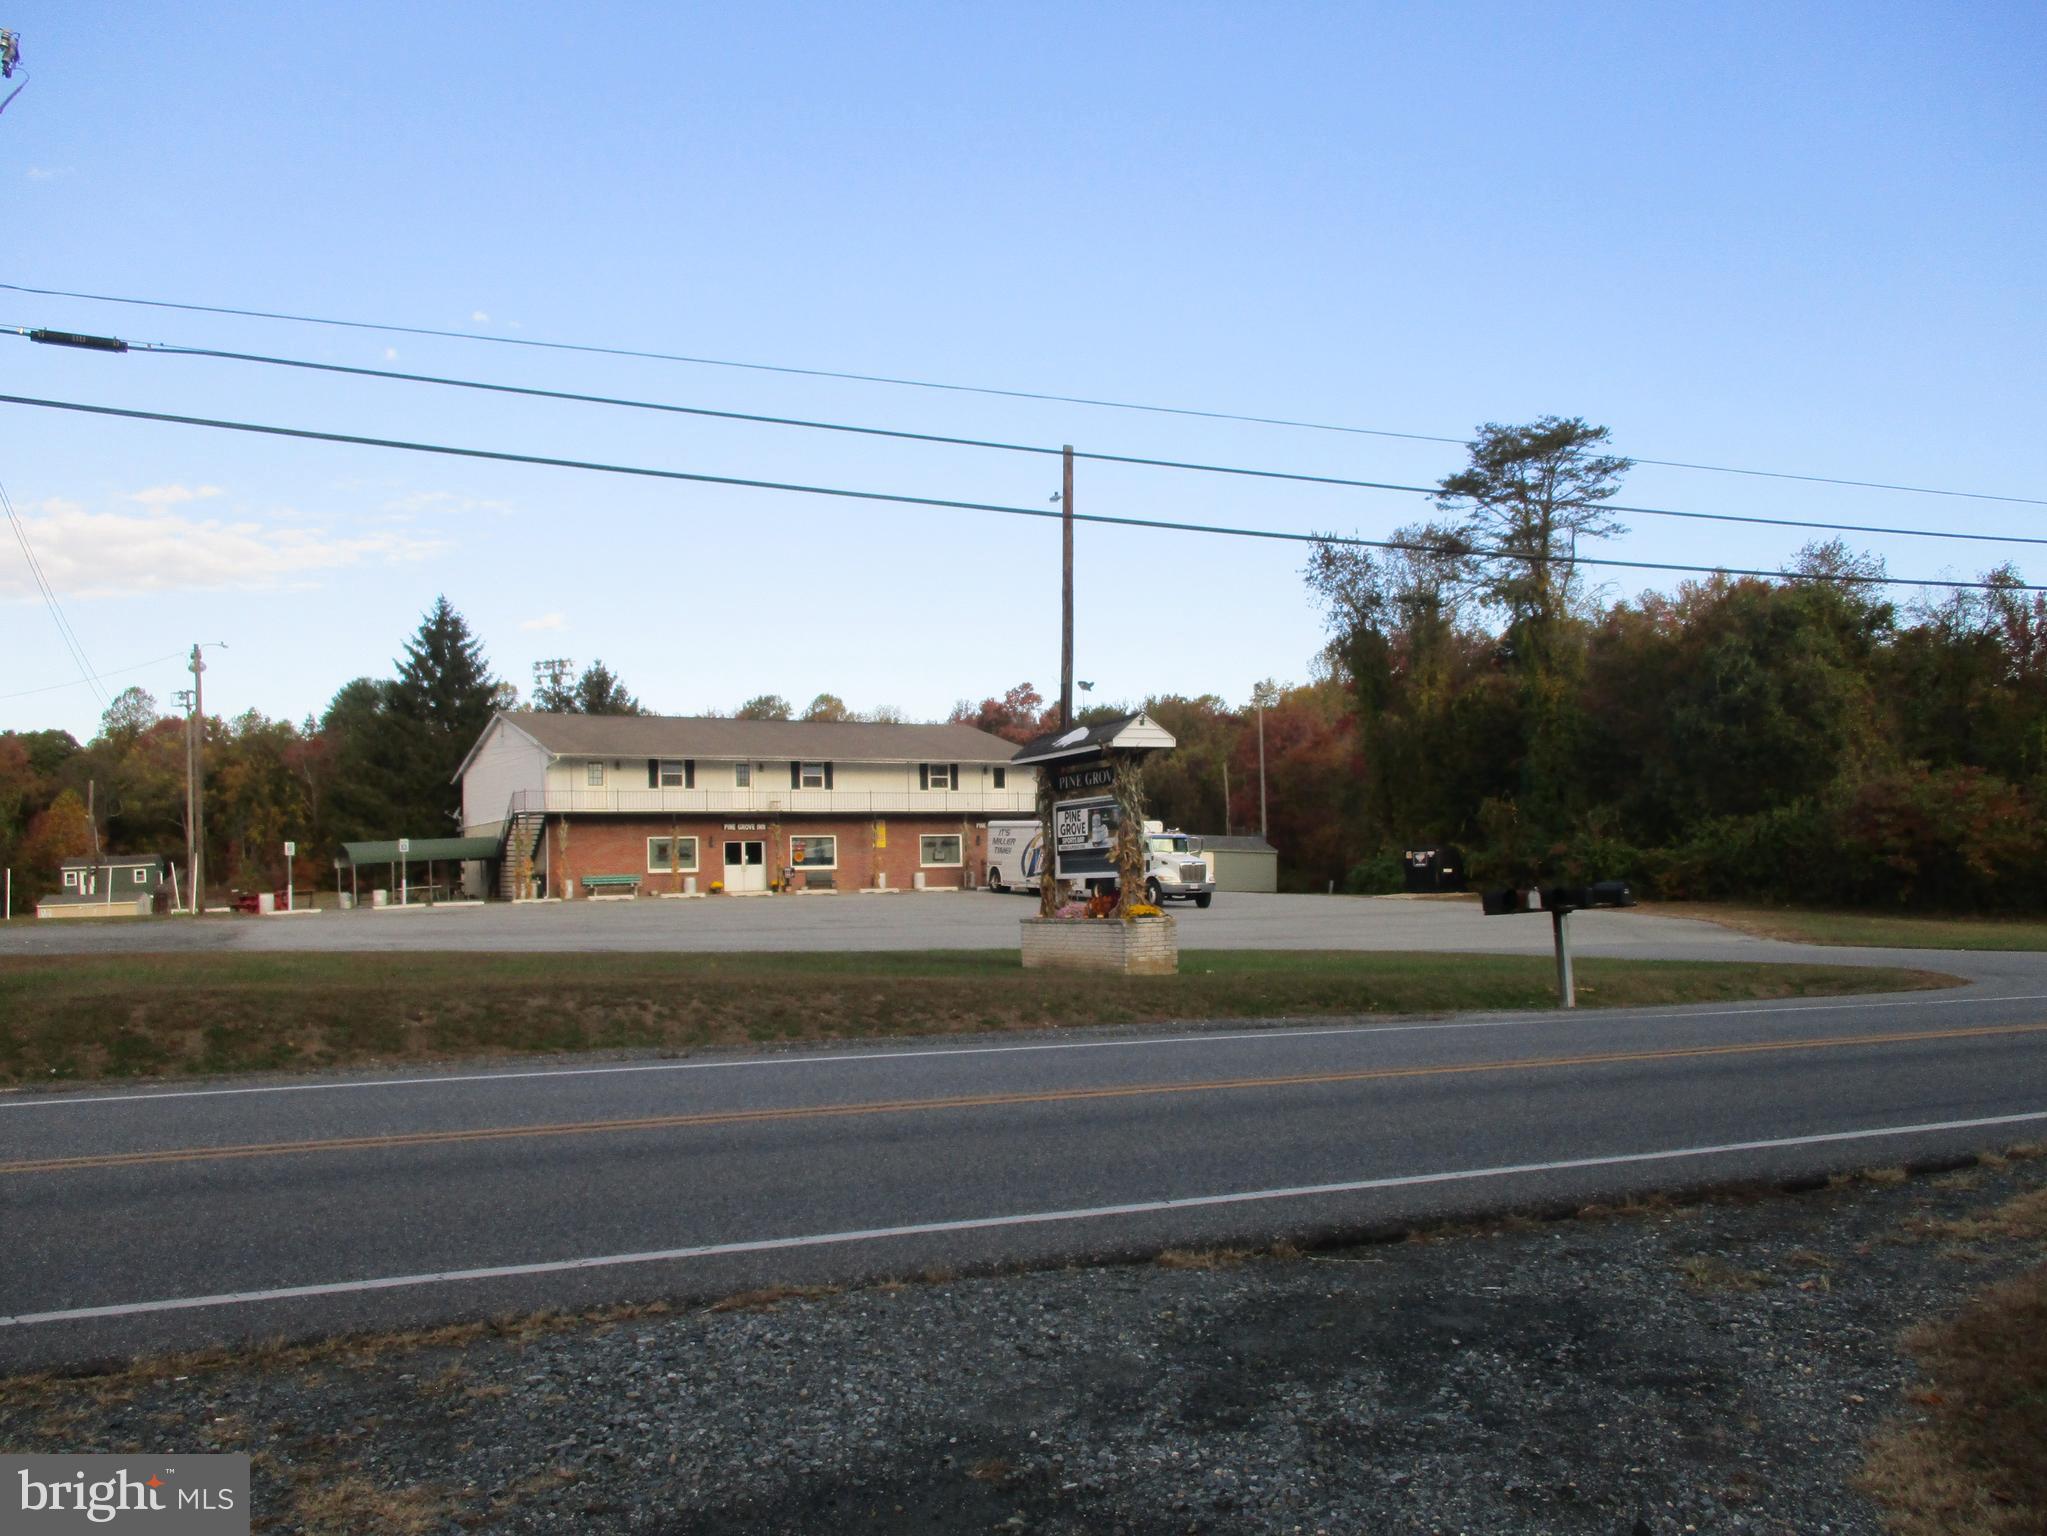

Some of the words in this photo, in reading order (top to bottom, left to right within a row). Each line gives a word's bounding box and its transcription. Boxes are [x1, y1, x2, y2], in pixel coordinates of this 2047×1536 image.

[1060, 774, 1081, 789] PINE
[1085, 770, 1112, 785] GROV
[1064, 810, 1081, 823] PINE
[1060, 822, 1086, 836] GROVE
[992, 838, 1016, 846] MILLER
